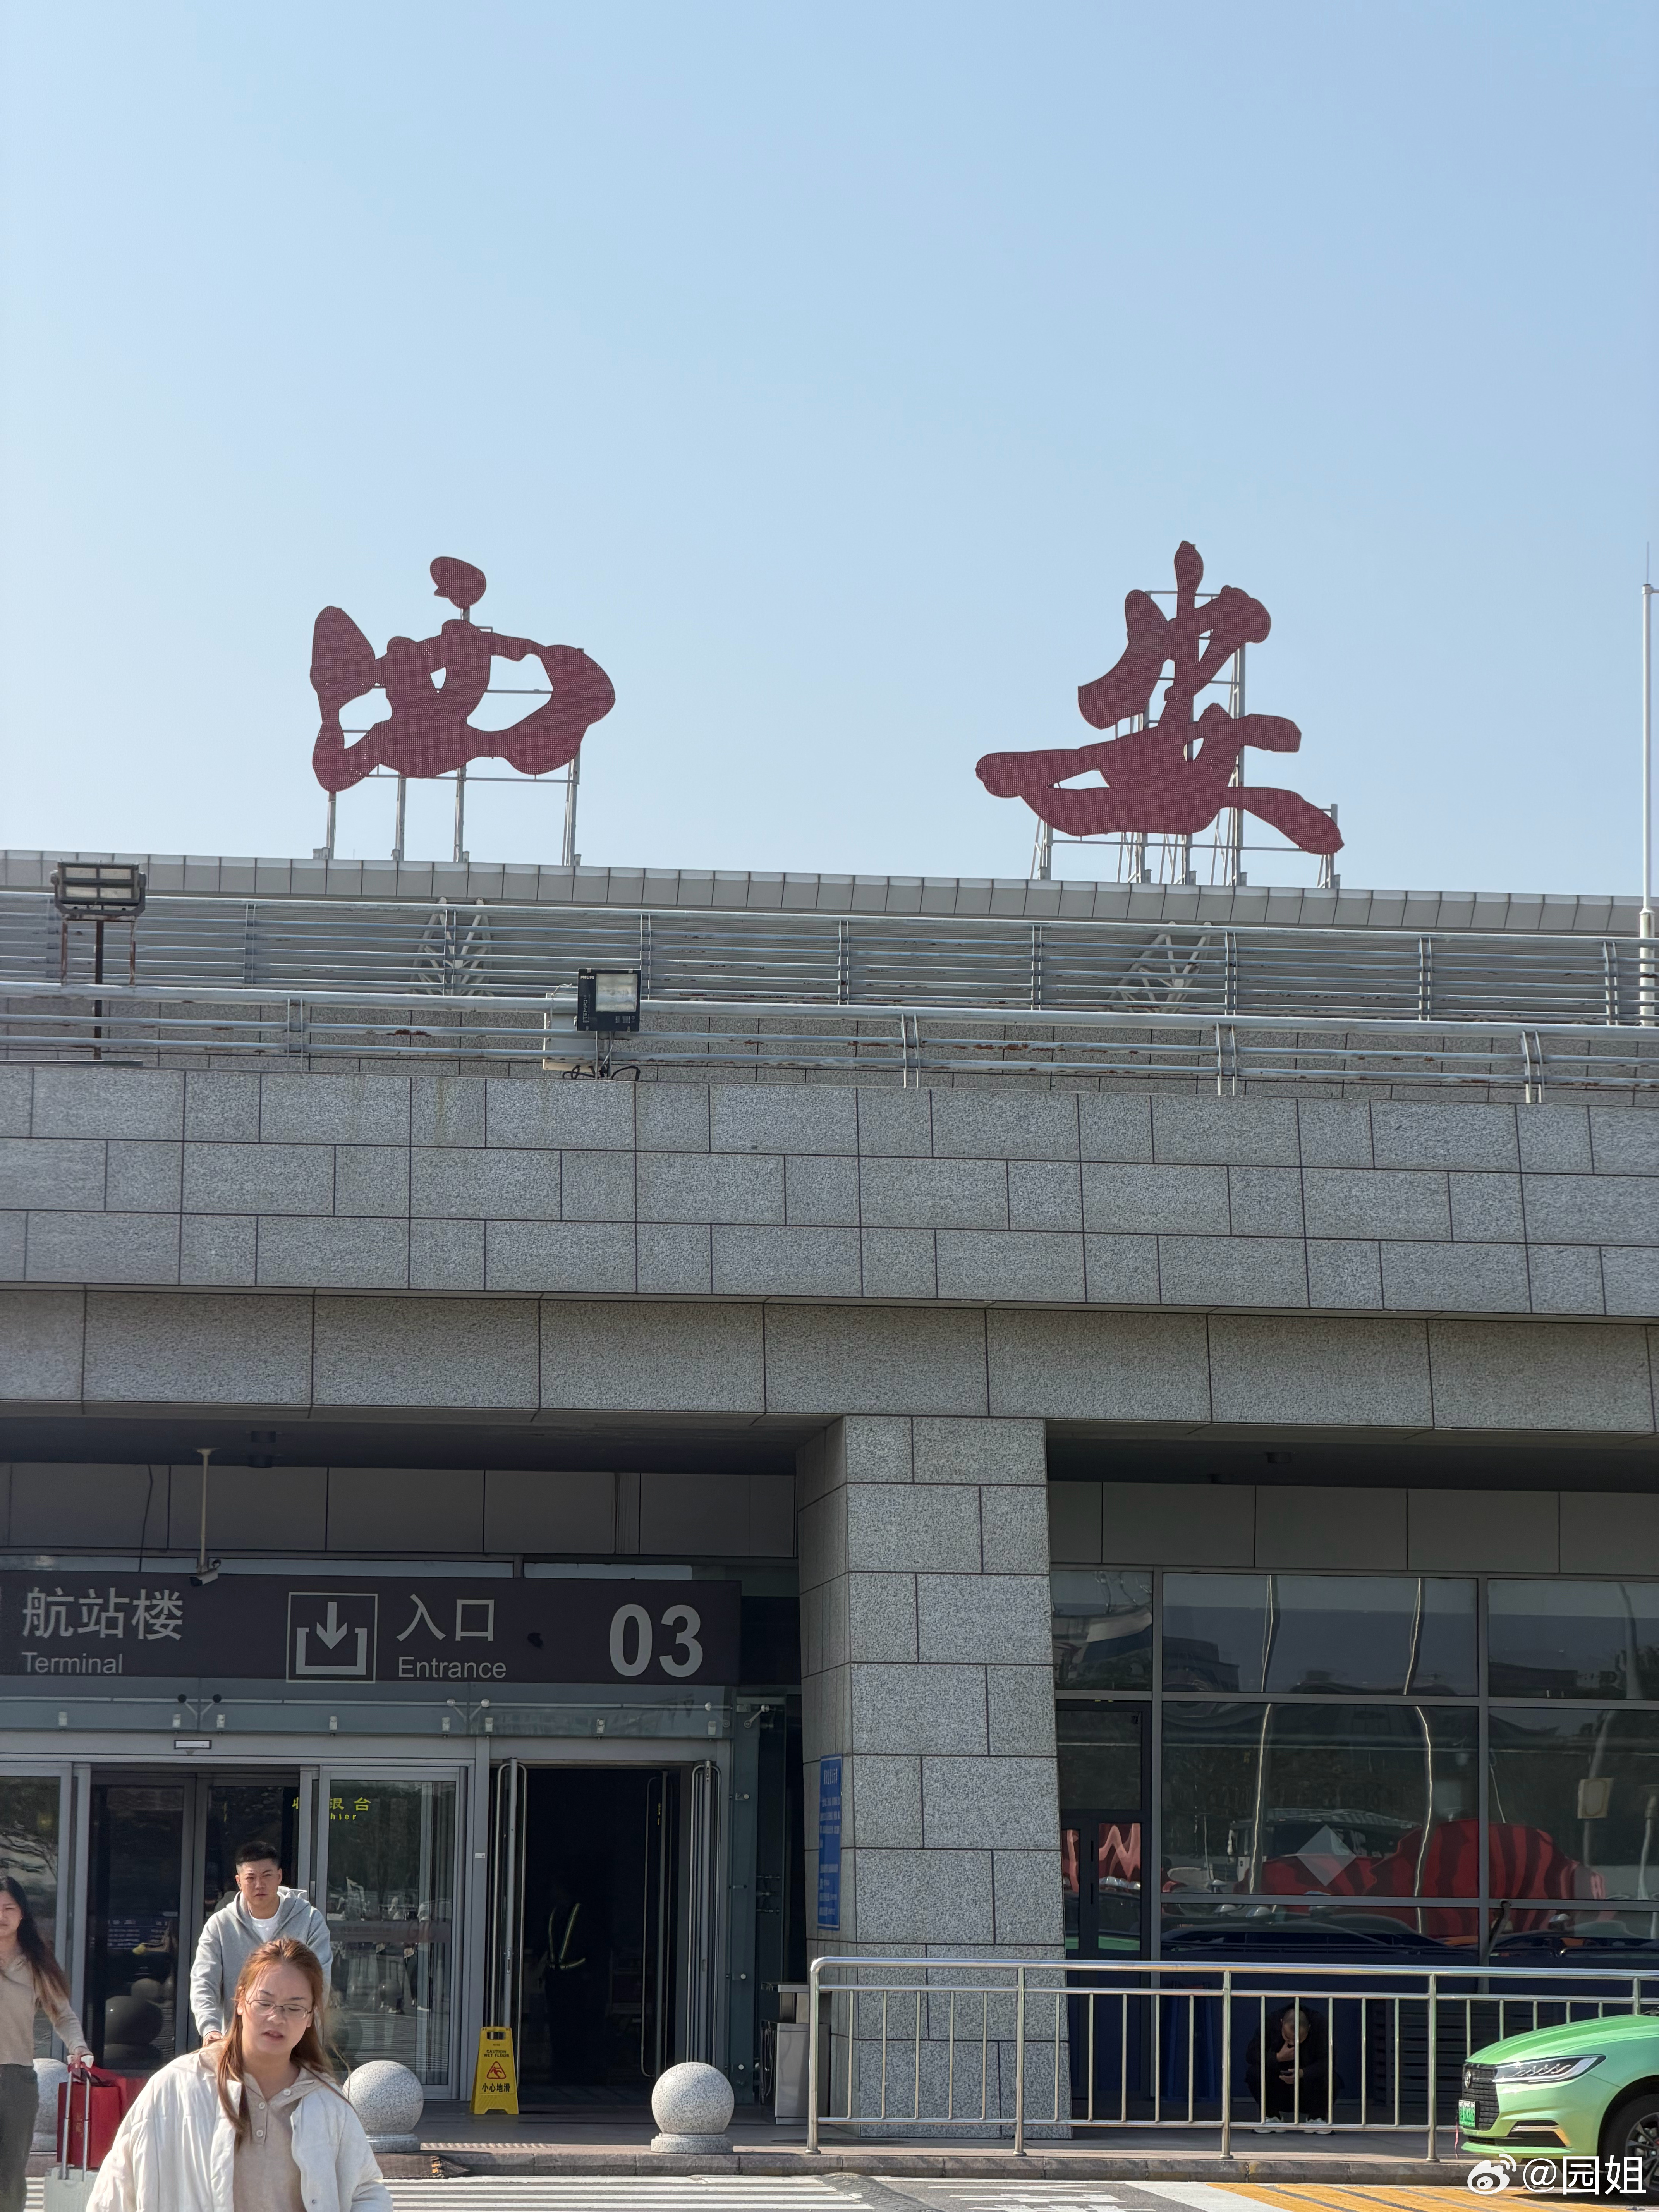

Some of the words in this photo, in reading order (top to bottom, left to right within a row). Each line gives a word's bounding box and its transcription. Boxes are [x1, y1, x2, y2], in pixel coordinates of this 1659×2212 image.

[22, 1587, 183, 1640] 航站楼
[396, 1594, 495, 1642] 入口
[610, 1604, 703, 1678] 03
[21, 1652, 122, 1674] Terminal
[398, 1656, 507, 1678] Entrance
[482, 2083, 510, 2092] 小心地滑
